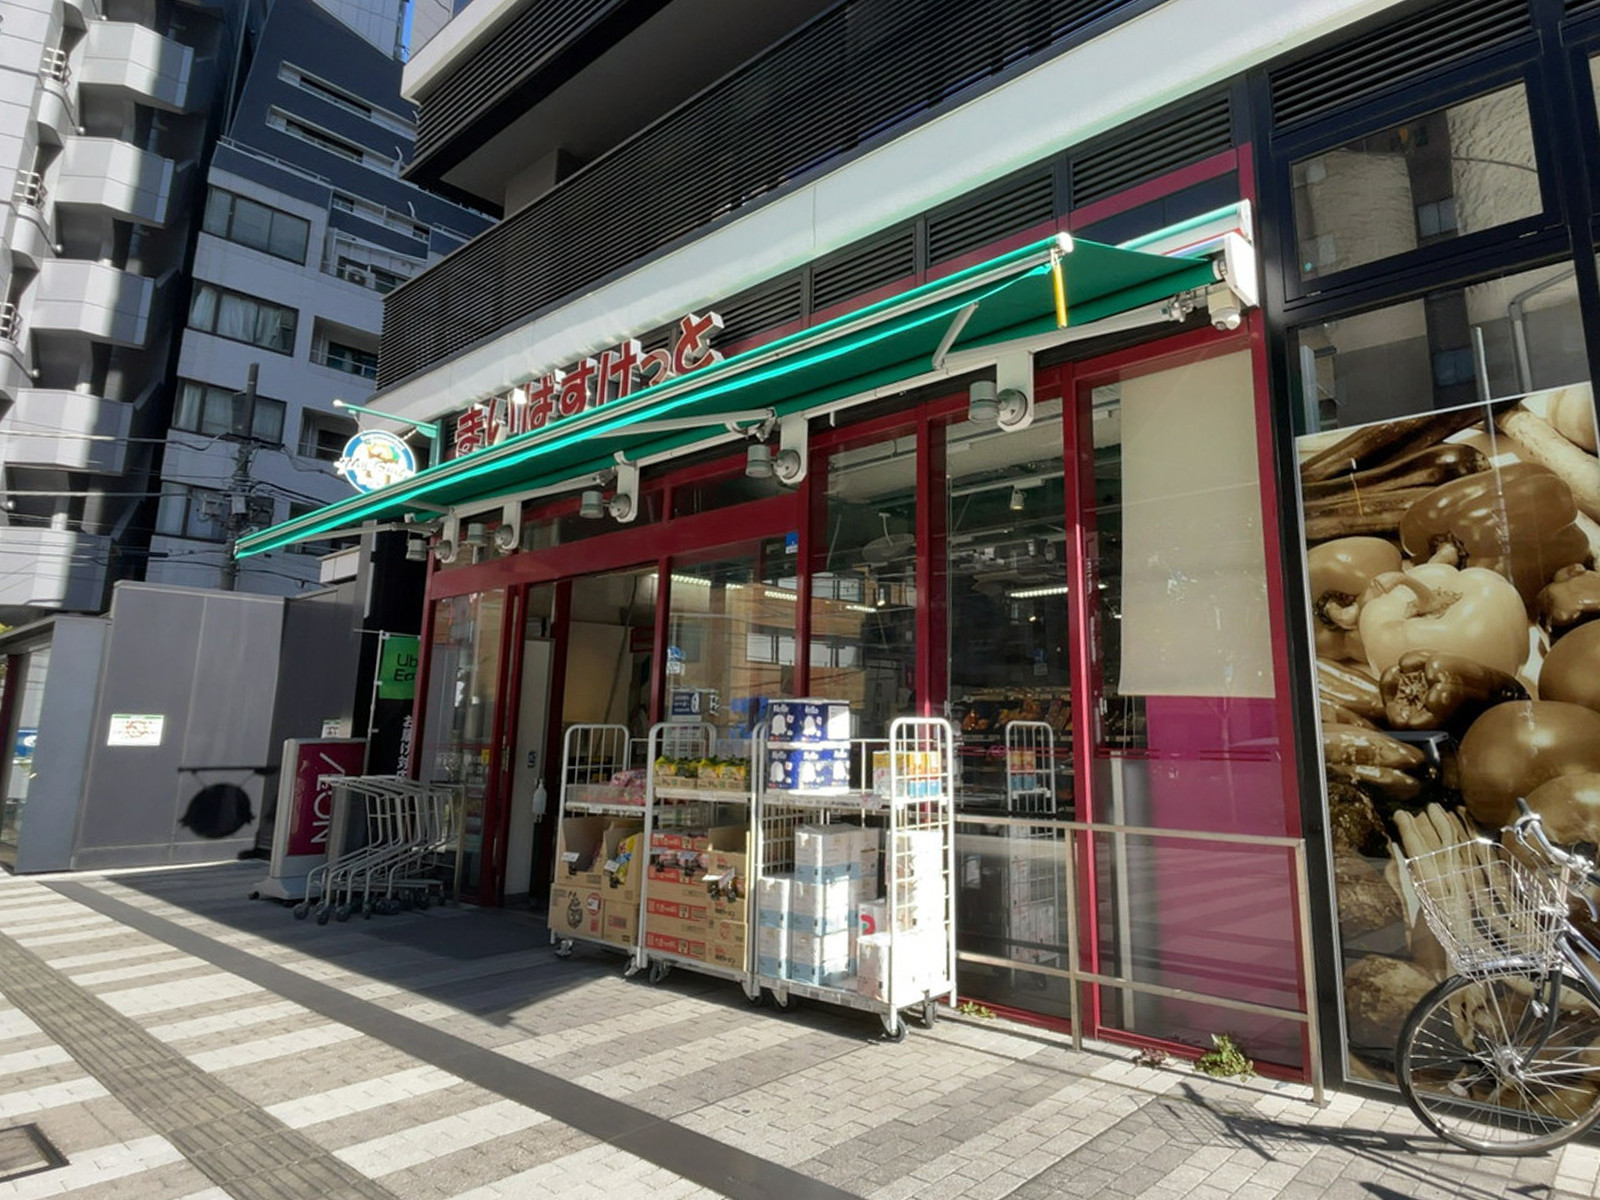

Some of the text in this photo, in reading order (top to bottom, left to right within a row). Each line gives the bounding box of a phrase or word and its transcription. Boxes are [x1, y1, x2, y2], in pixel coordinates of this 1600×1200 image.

[455, 311, 724, 459] まいばすけっと
[397, 653, 418, 667] Ub
[394, 668, 416, 682] Ea
